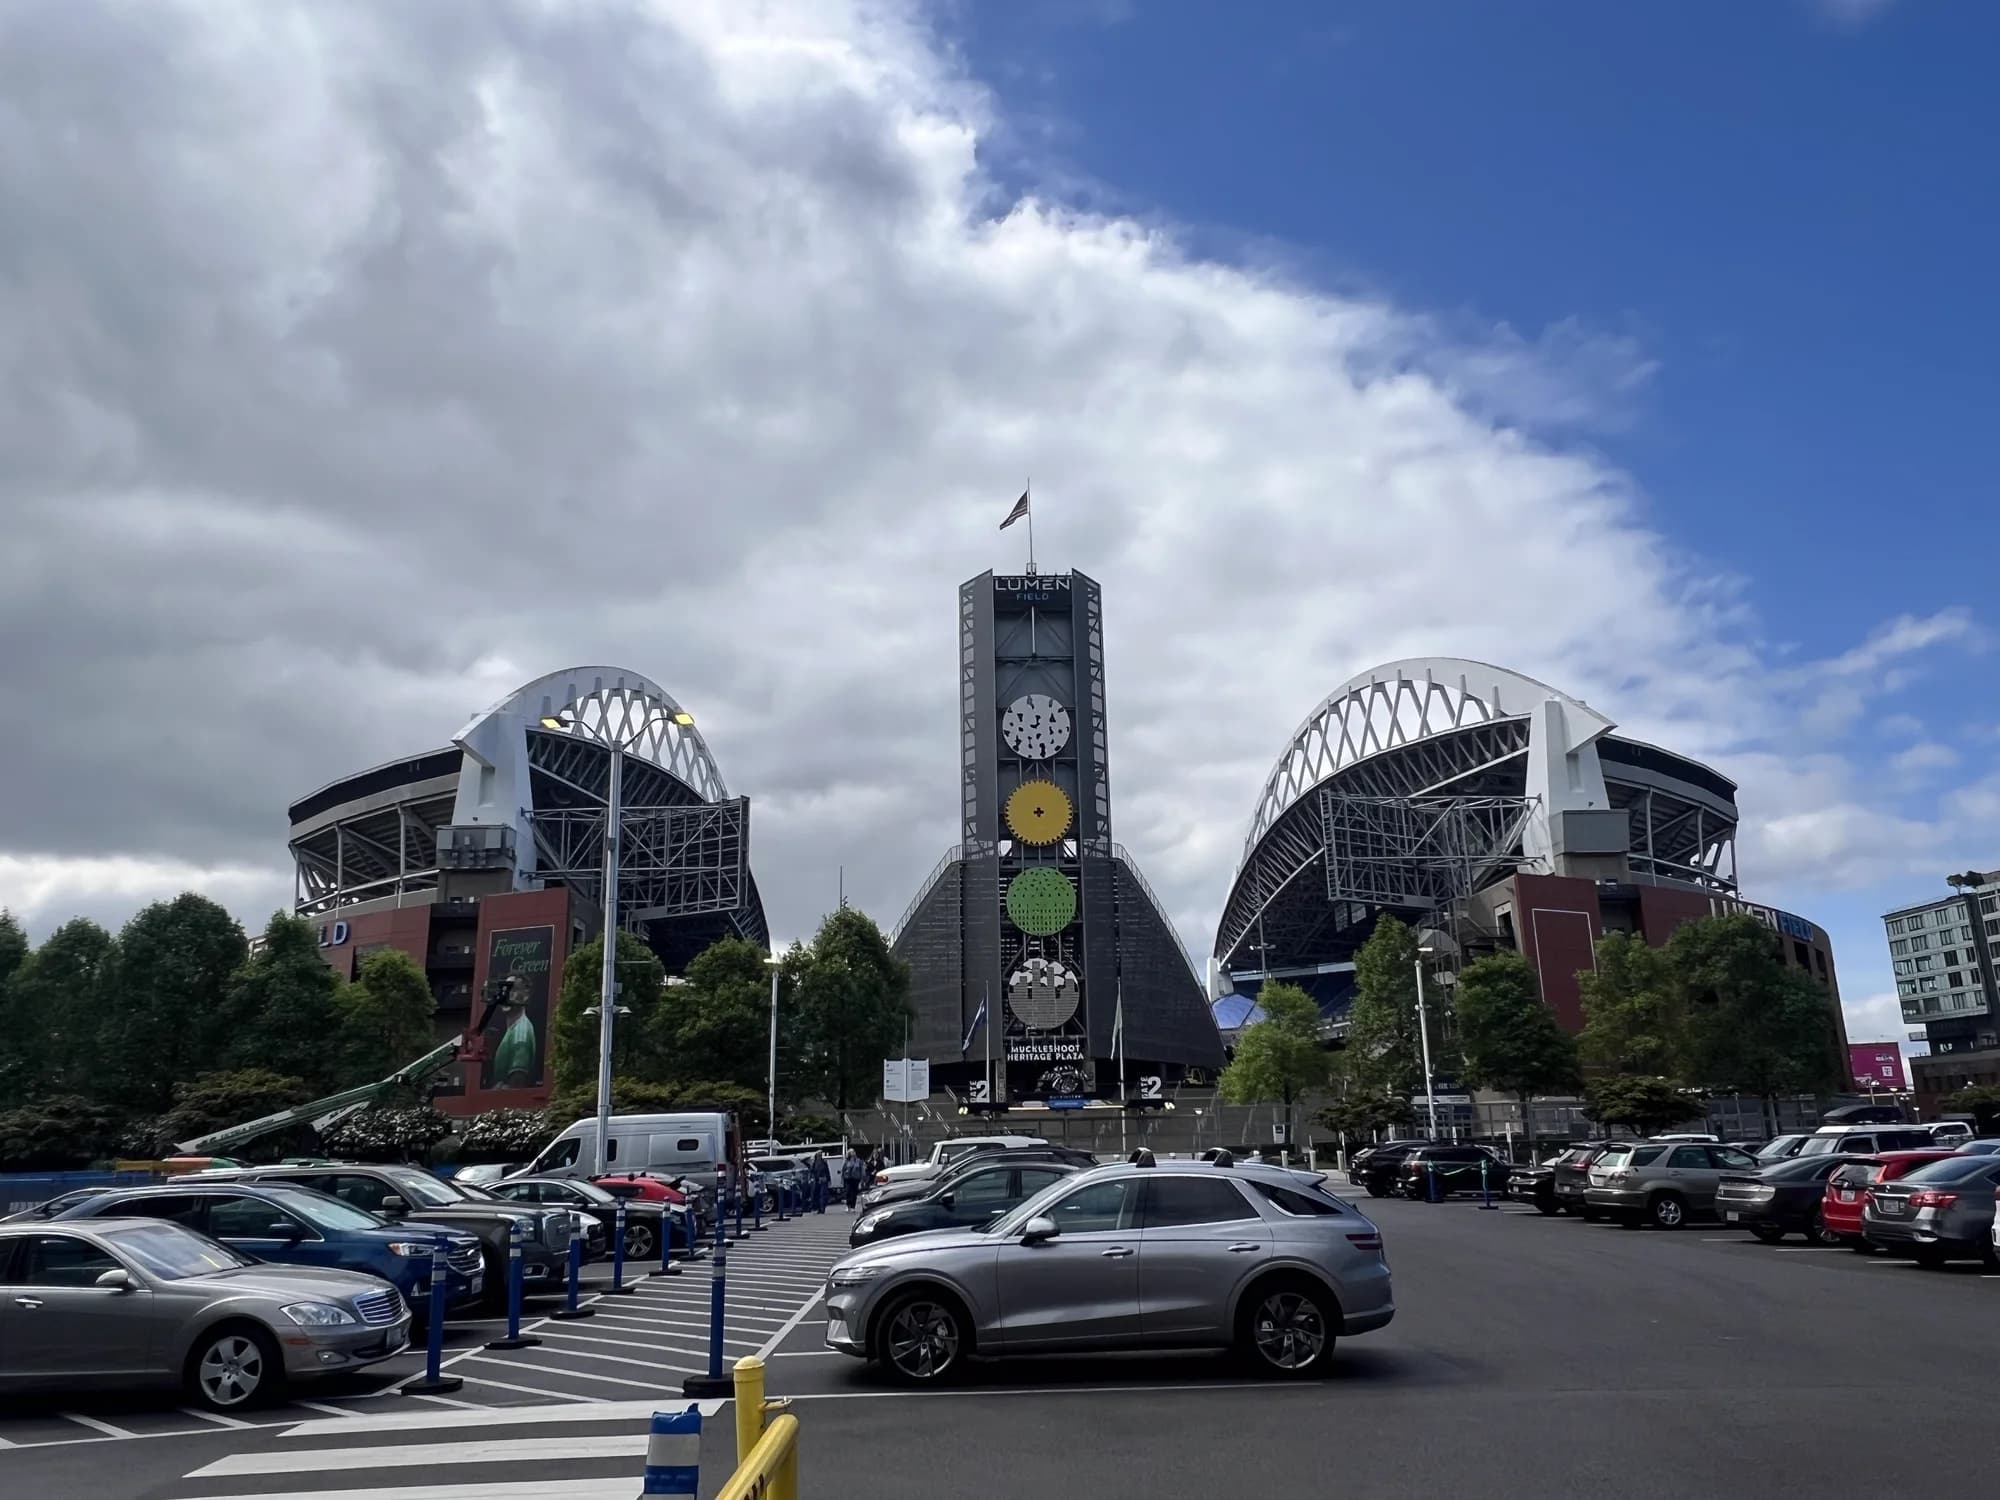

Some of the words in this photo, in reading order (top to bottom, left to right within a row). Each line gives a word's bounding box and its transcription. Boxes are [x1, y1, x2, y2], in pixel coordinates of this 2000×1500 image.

[995, 579, 1070, 591] LUMEN
[1016, 592, 1049, 601] FIELD
[492, 939, 541, 957] Forever
[510, 956, 549, 973] Green
[1011, 1044, 1080, 1053] MUCKLESHOOT
[1007, 1053, 1052, 1061] HERITAGE
[1055, 1052, 1084, 1060] PLAZA
[976, 1080, 990, 1103] 2
[1148, 1076, 1162, 1099] 2
